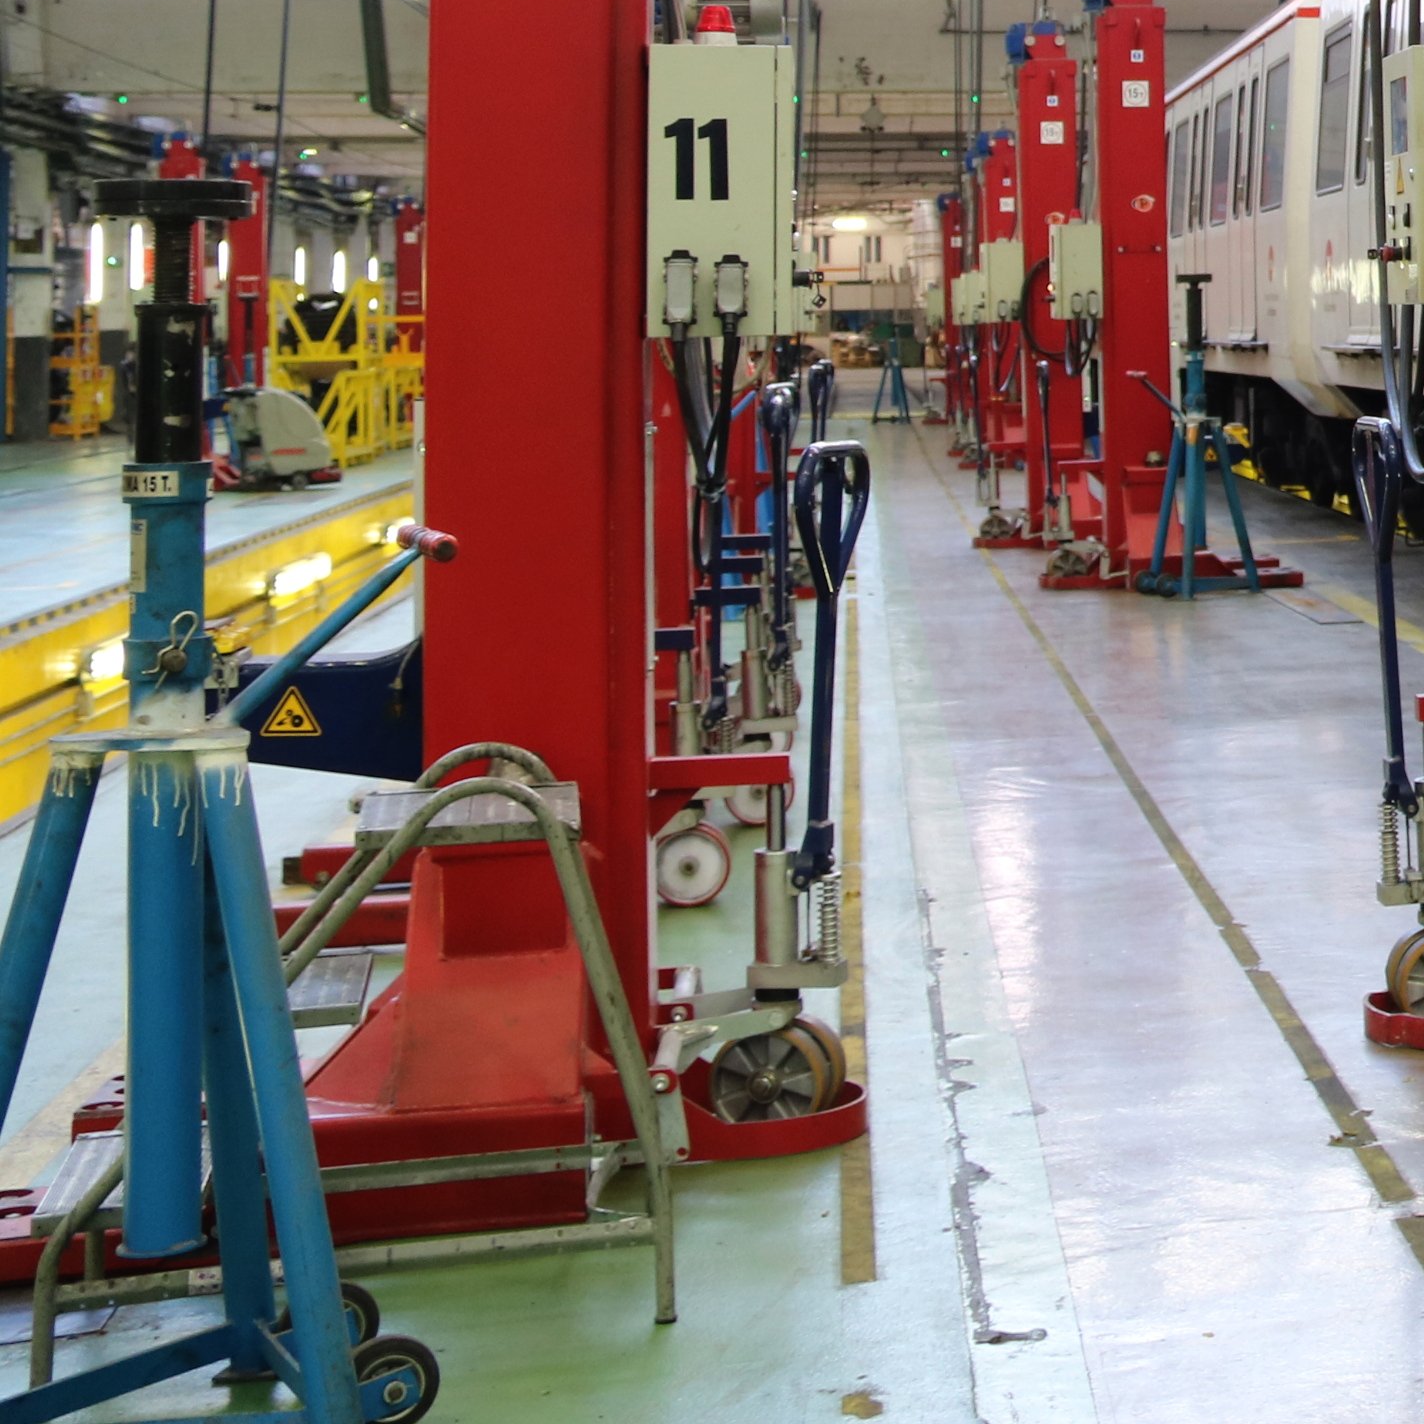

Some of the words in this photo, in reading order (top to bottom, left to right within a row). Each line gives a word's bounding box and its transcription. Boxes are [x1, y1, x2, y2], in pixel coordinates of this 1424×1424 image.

[664, 118, 729, 200] 11
[143, 476, 157, 492] 15
[161, 475, 172, 492] T.
